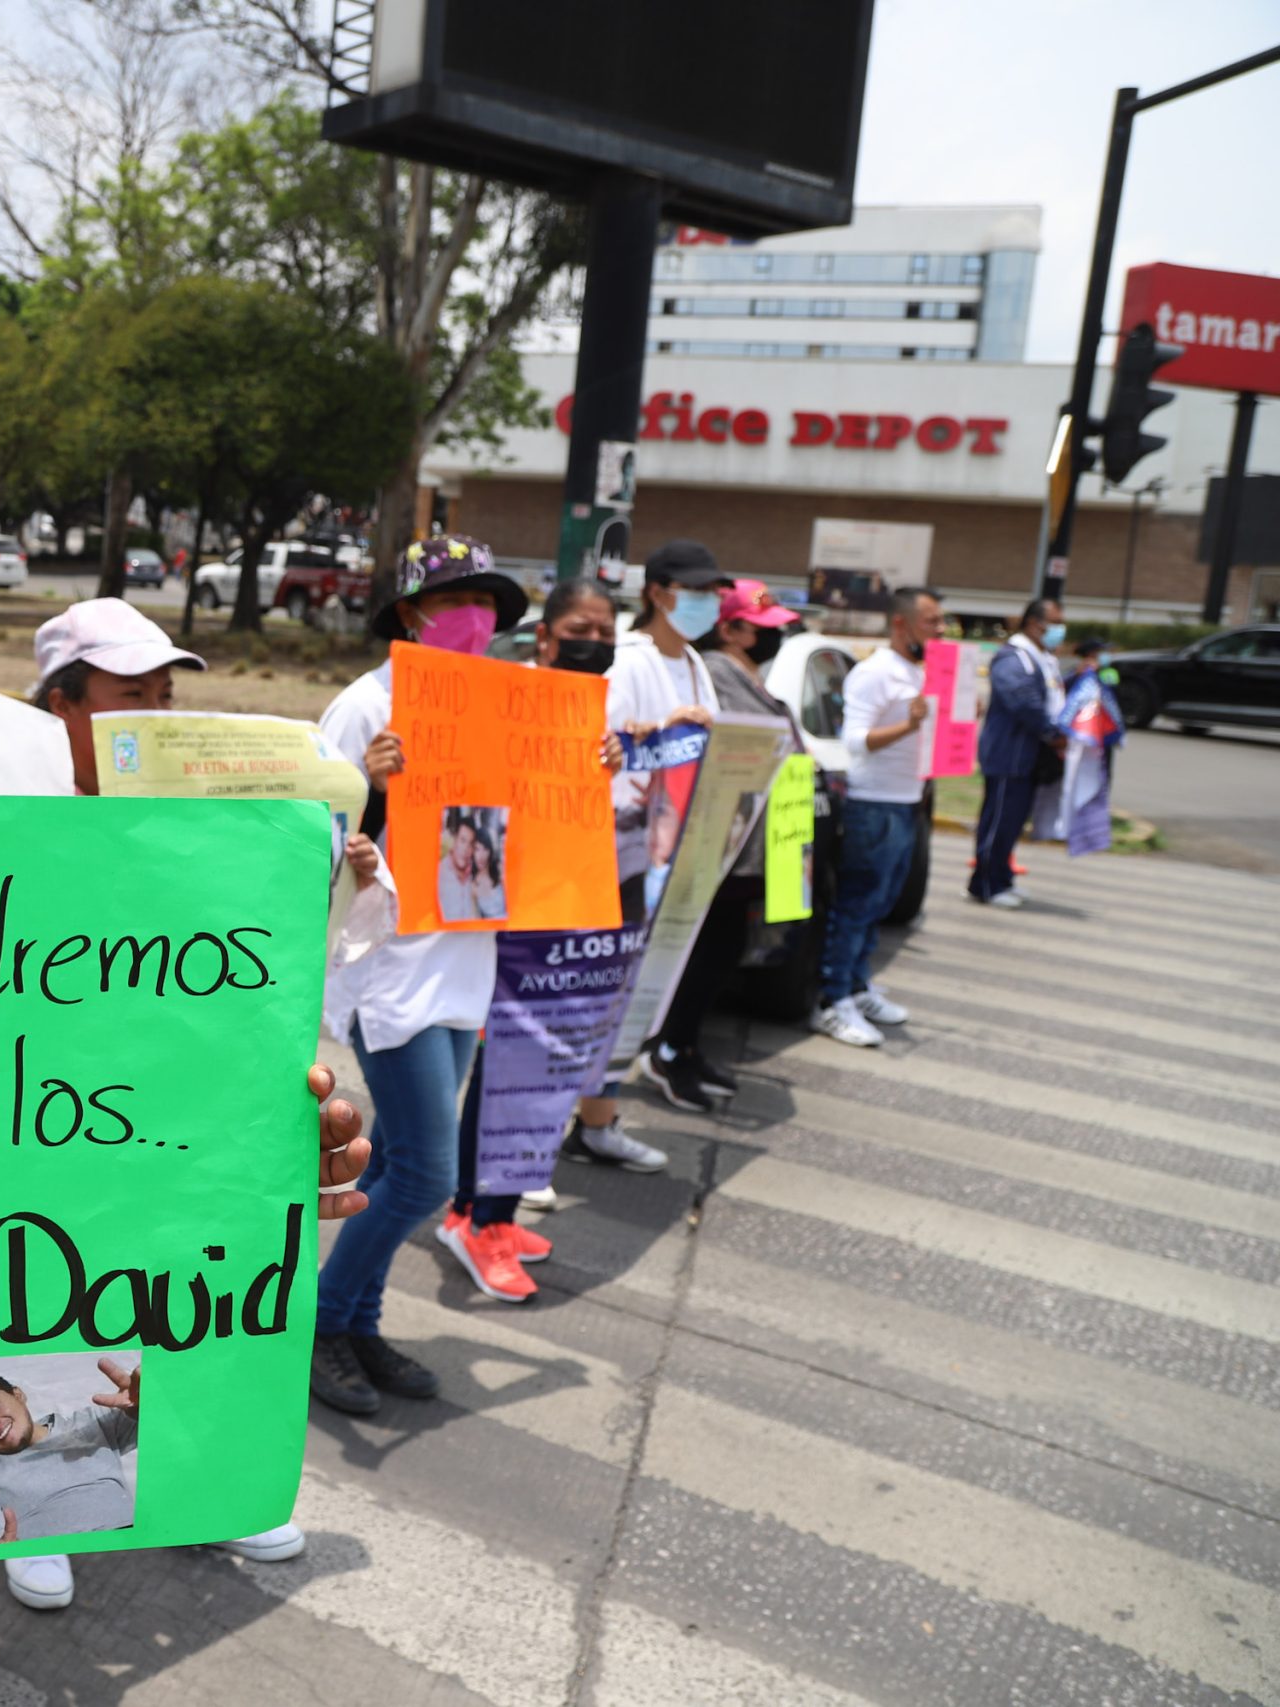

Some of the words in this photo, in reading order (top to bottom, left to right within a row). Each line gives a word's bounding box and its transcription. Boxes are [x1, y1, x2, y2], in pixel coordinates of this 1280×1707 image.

[790, 411, 1008, 455] DEPOT
[405, 664, 469, 717] DAVID
[496, 680, 587, 727] JOSELIN
[545, 934, 616, 966] ¿LOS
